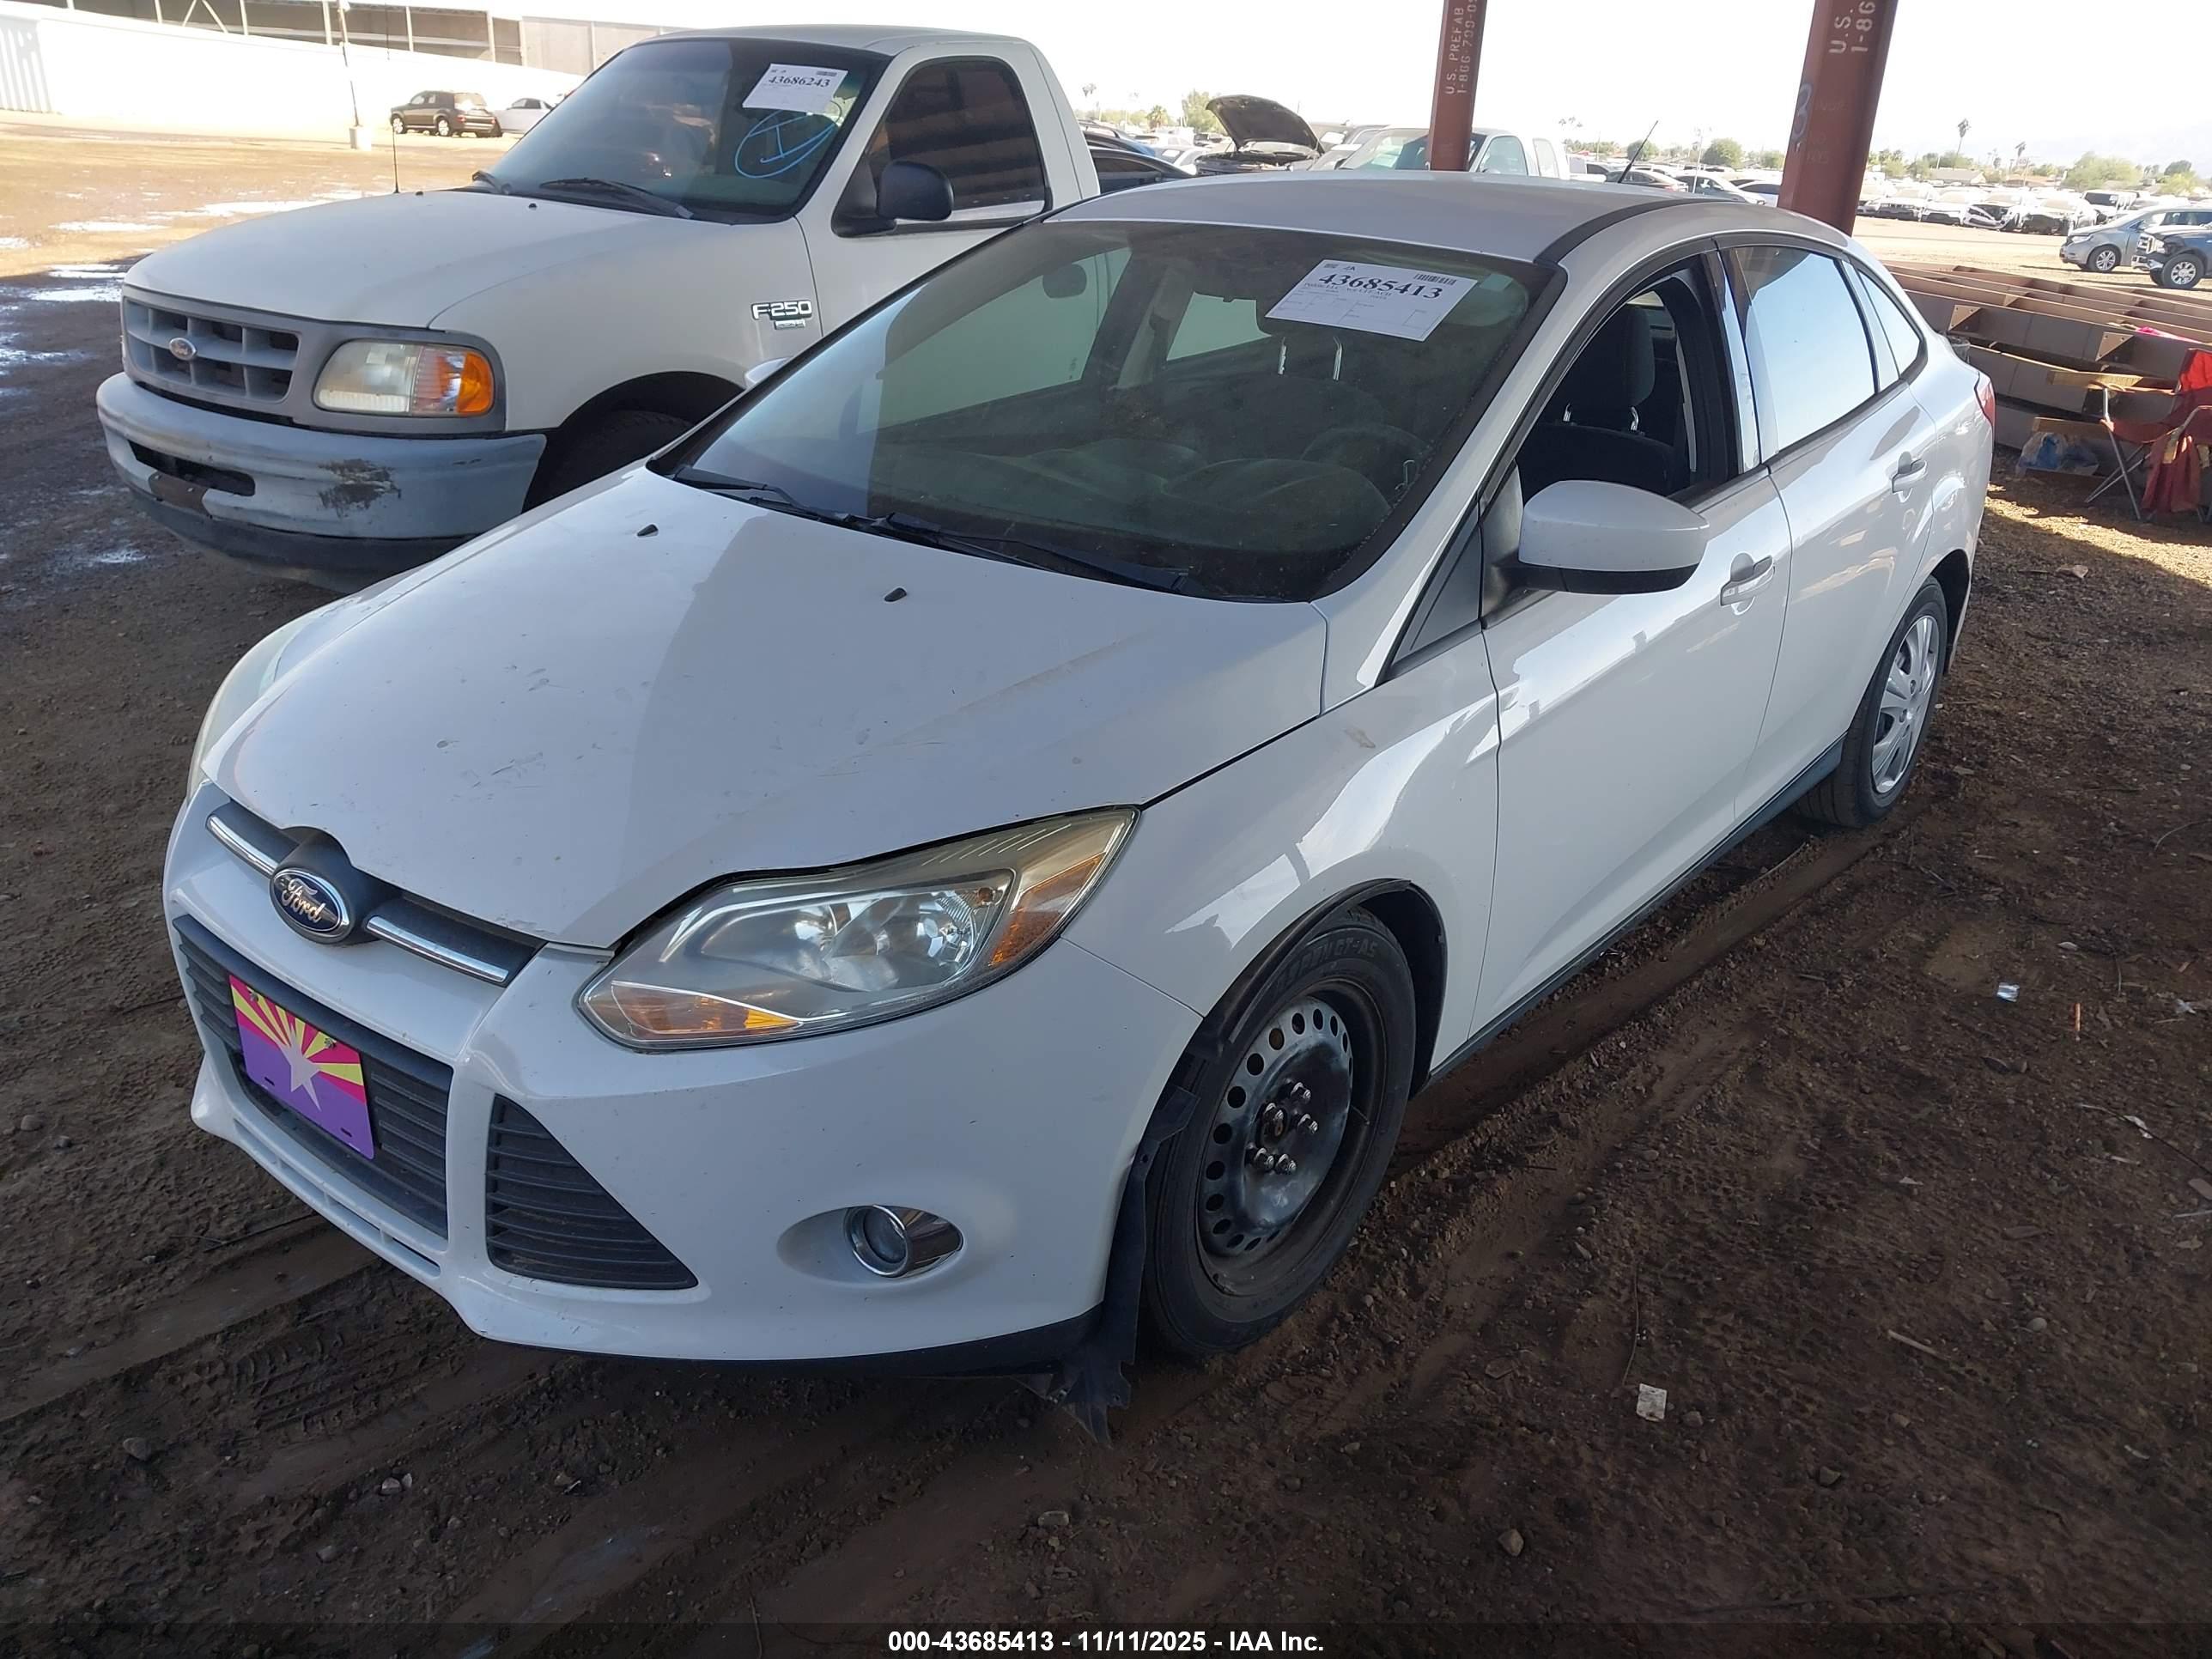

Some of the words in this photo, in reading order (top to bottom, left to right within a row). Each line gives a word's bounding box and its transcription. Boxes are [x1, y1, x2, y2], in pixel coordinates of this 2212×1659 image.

[1449, 7, 1465, 61] PREFAB
[769, 76, 830, 88] 43686243
[1318, 272, 1443, 300] 43685413
[281, 878, 326, 924] Ford
